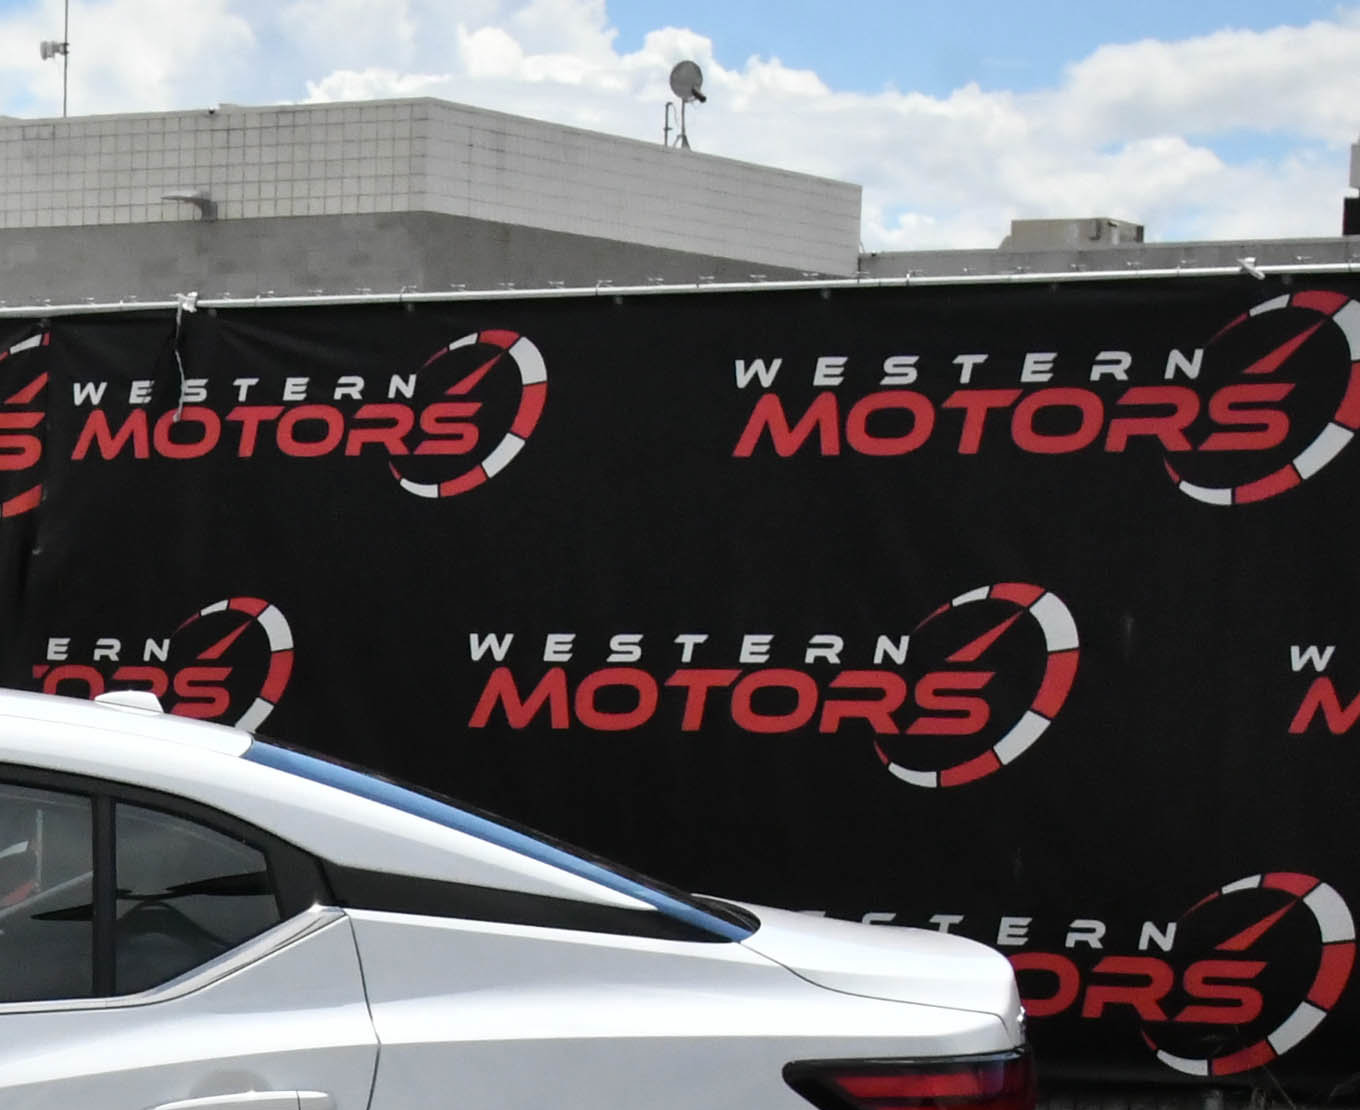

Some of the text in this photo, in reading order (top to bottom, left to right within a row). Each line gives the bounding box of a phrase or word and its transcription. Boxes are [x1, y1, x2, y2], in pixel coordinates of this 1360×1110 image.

[73, 373, 417, 407] WESTERN
[735, 348, 1204, 389] WESTERN
[71, 402, 483, 461] MOTORS
[733, 383, 1295, 457] MOTORS
[469, 632, 910, 665] WESTERN
[32, 664, 233, 718] ORS
[468, 666, 995, 735] MOTORS
